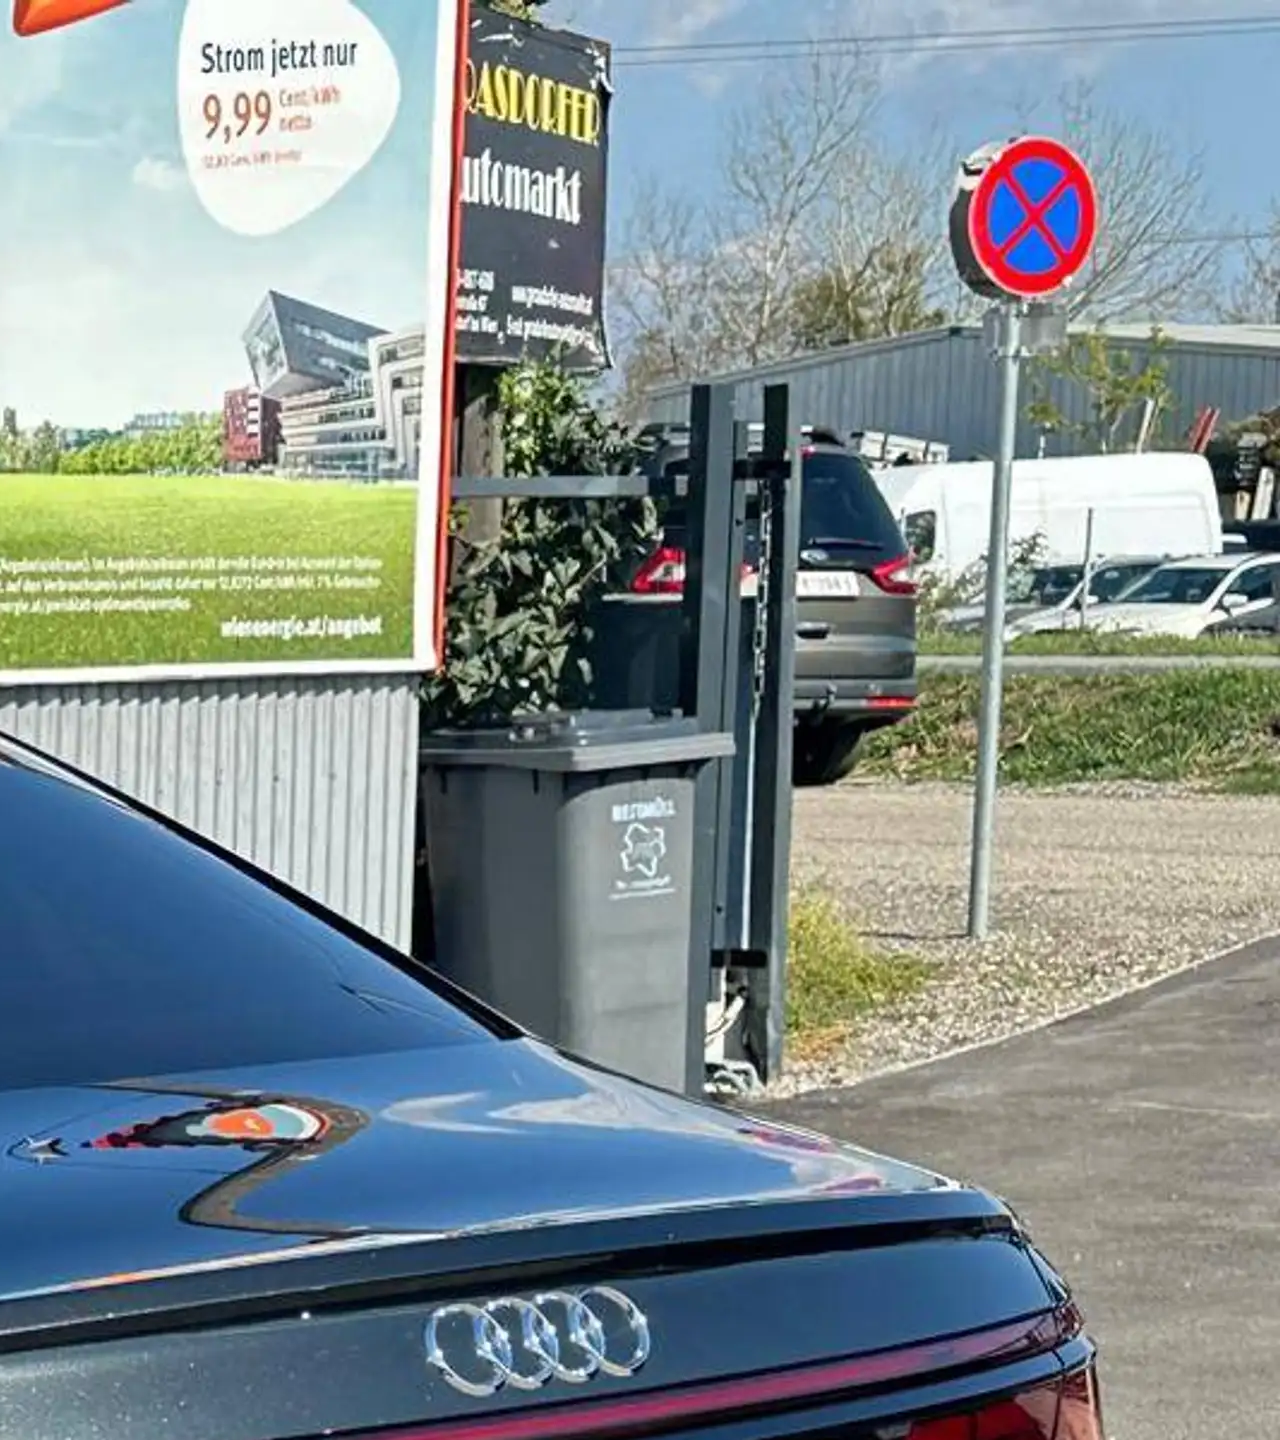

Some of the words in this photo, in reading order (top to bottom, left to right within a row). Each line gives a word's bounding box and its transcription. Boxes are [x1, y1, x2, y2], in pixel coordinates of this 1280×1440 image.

[200, 43, 264, 73] Strom
[271, 38, 317, 77] jetzt
[323, 43, 358, 66] nur
[203, 90, 272, 144] 9,99
[464, 58, 602, 148] RASDORFER
[461, 147, 582, 225] utomarkt
[220, 614, 383, 641] wienenergie.at/angebot
